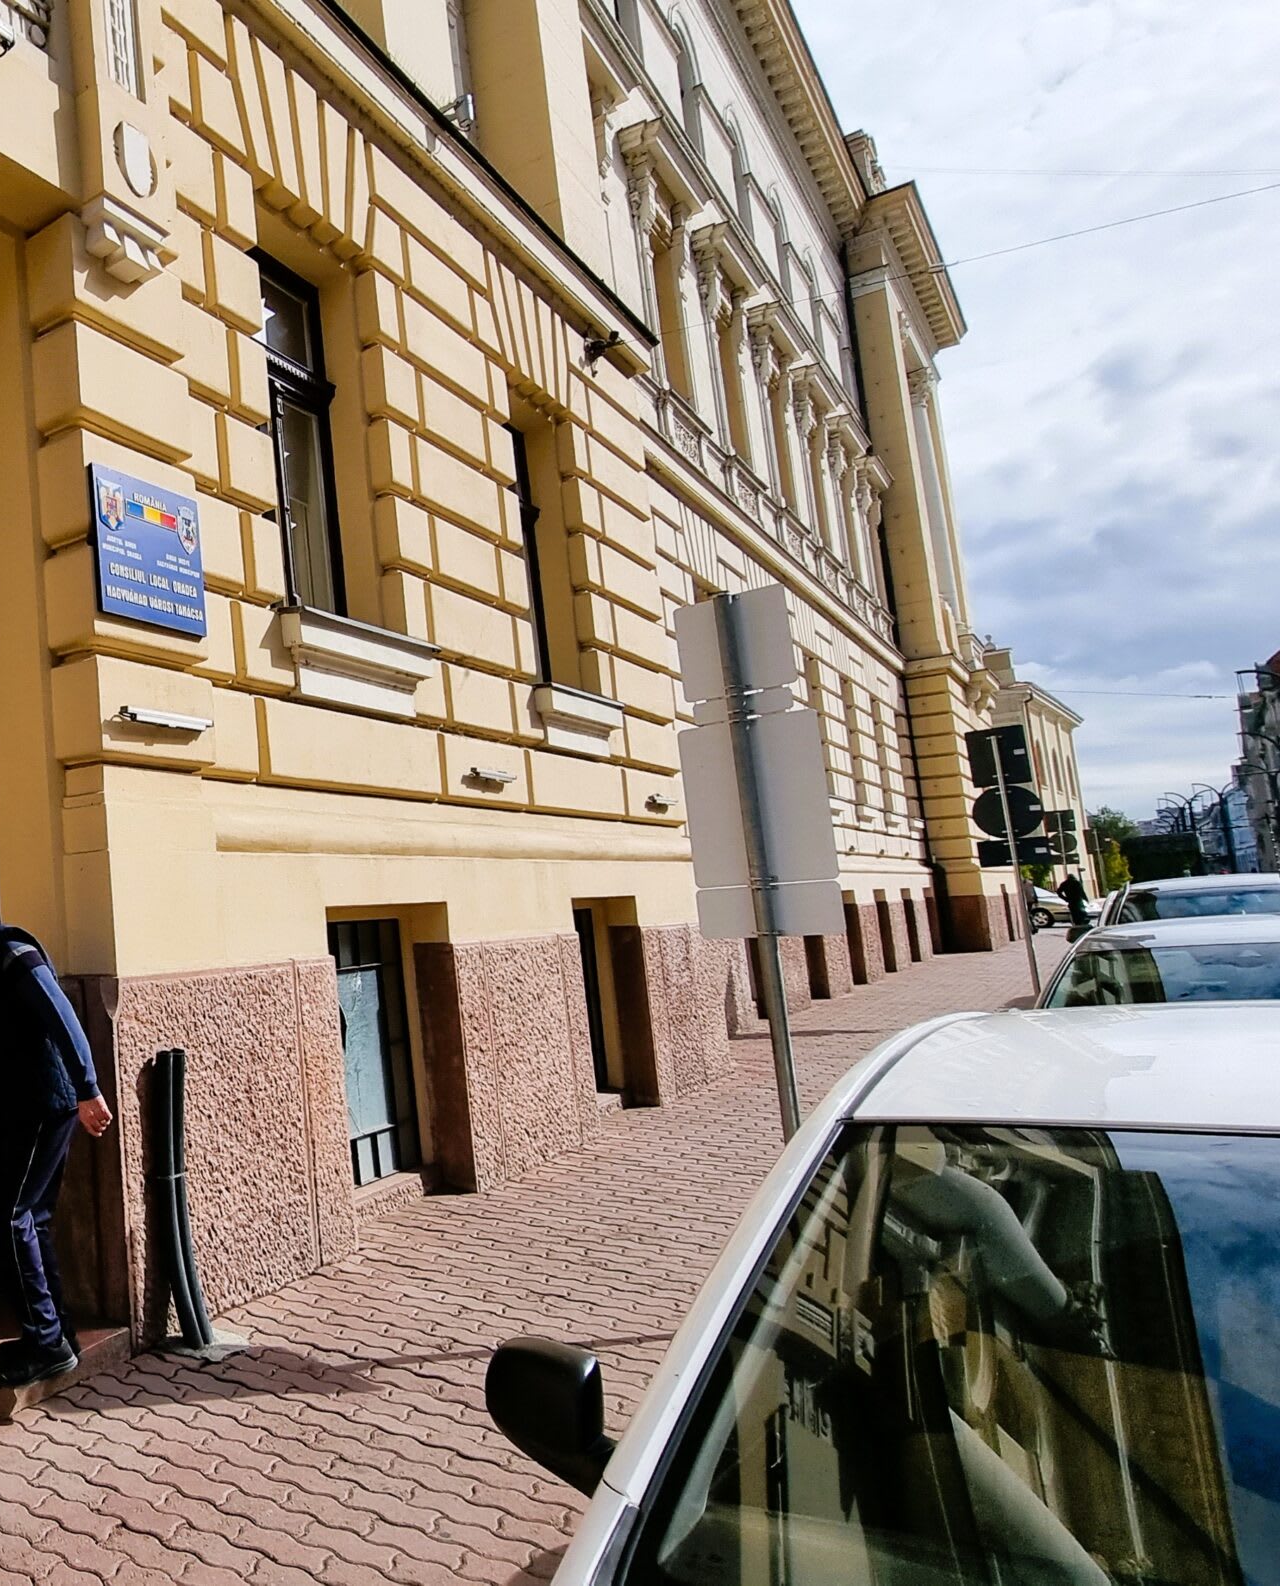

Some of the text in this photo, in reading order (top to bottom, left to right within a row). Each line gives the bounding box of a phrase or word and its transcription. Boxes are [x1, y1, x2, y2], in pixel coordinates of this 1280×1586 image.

[109, 562, 147, 584] CONSILIUL
[149, 573, 170, 591] LOCAL
[172, 580, 198, 599] ORADEA
